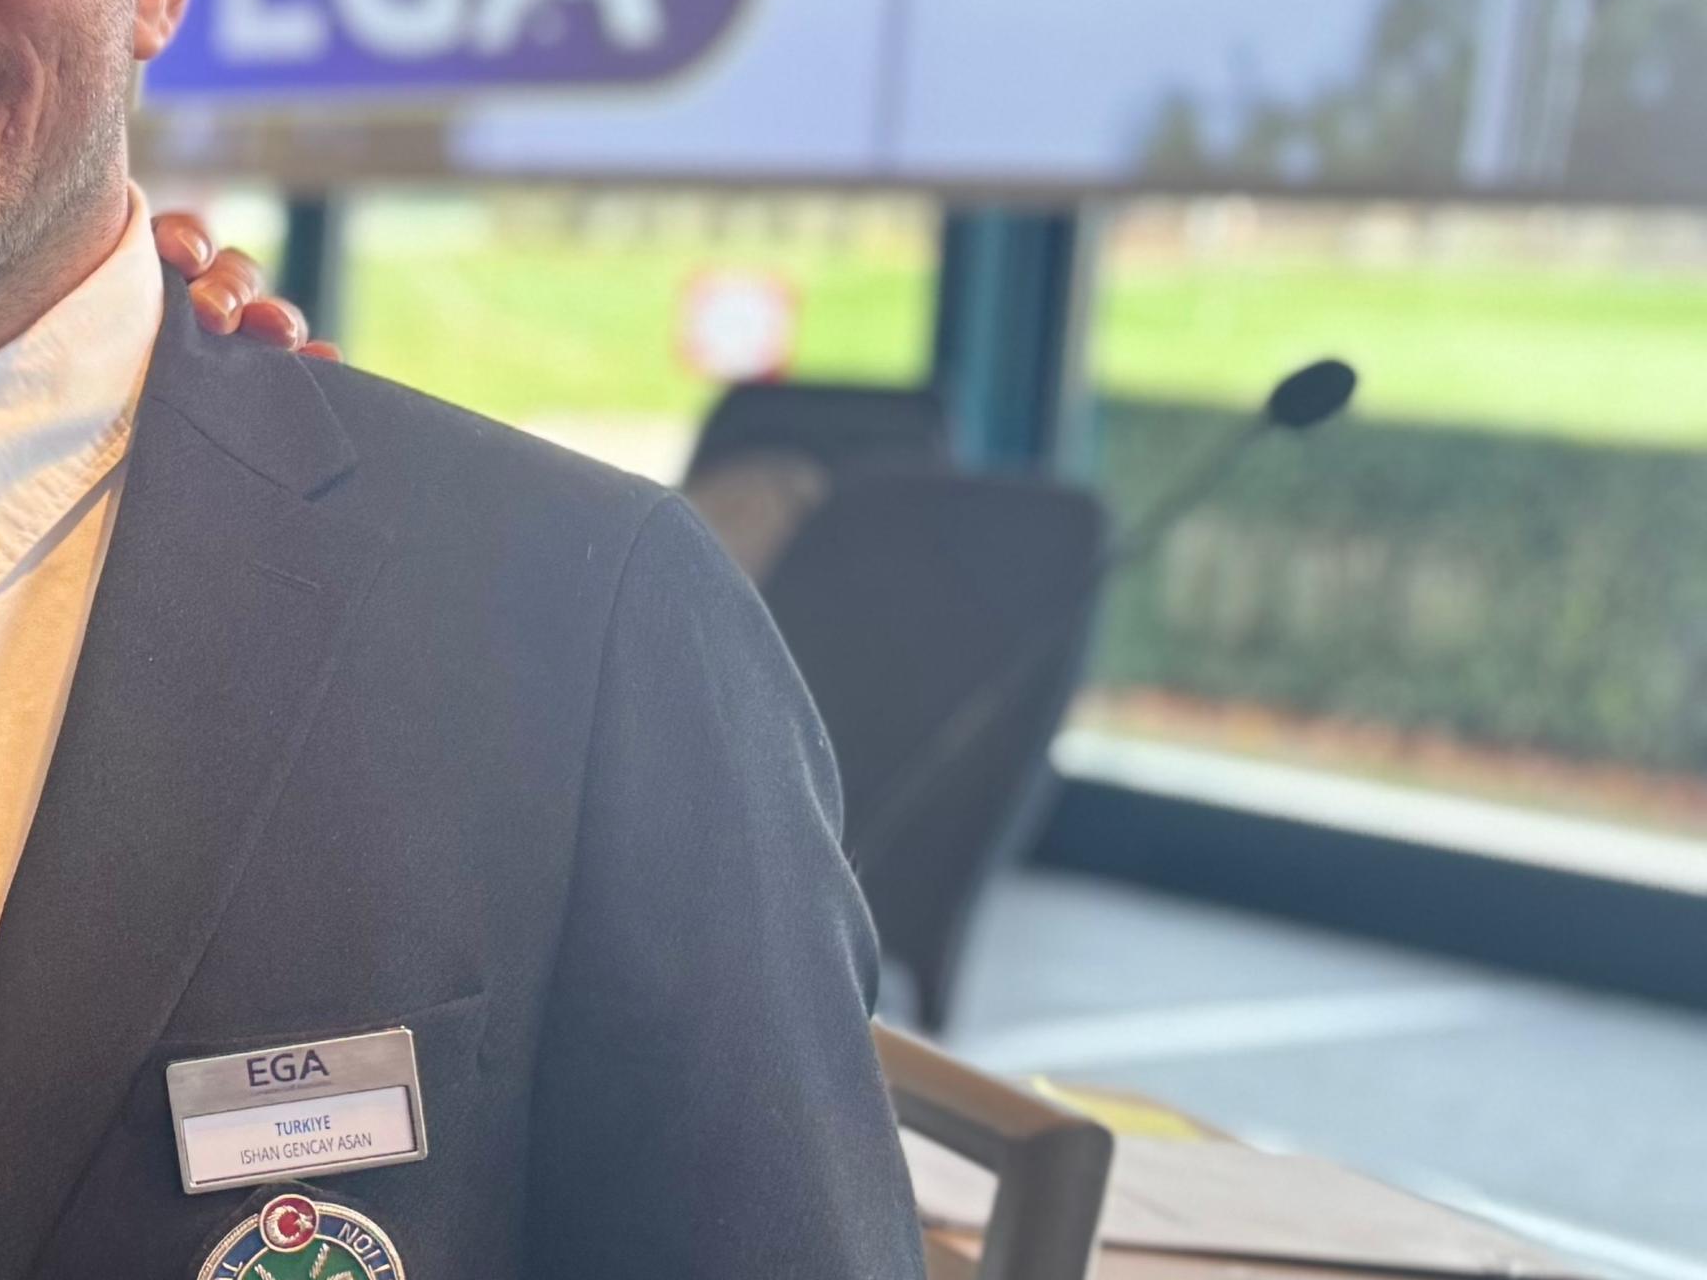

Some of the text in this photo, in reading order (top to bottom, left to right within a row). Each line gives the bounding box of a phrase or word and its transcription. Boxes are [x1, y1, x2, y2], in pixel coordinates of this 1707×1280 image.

[246, 1049, 330, 1087] EGA
[240, 1132, 372, 1165] ISHAN GENCAY ASAN
